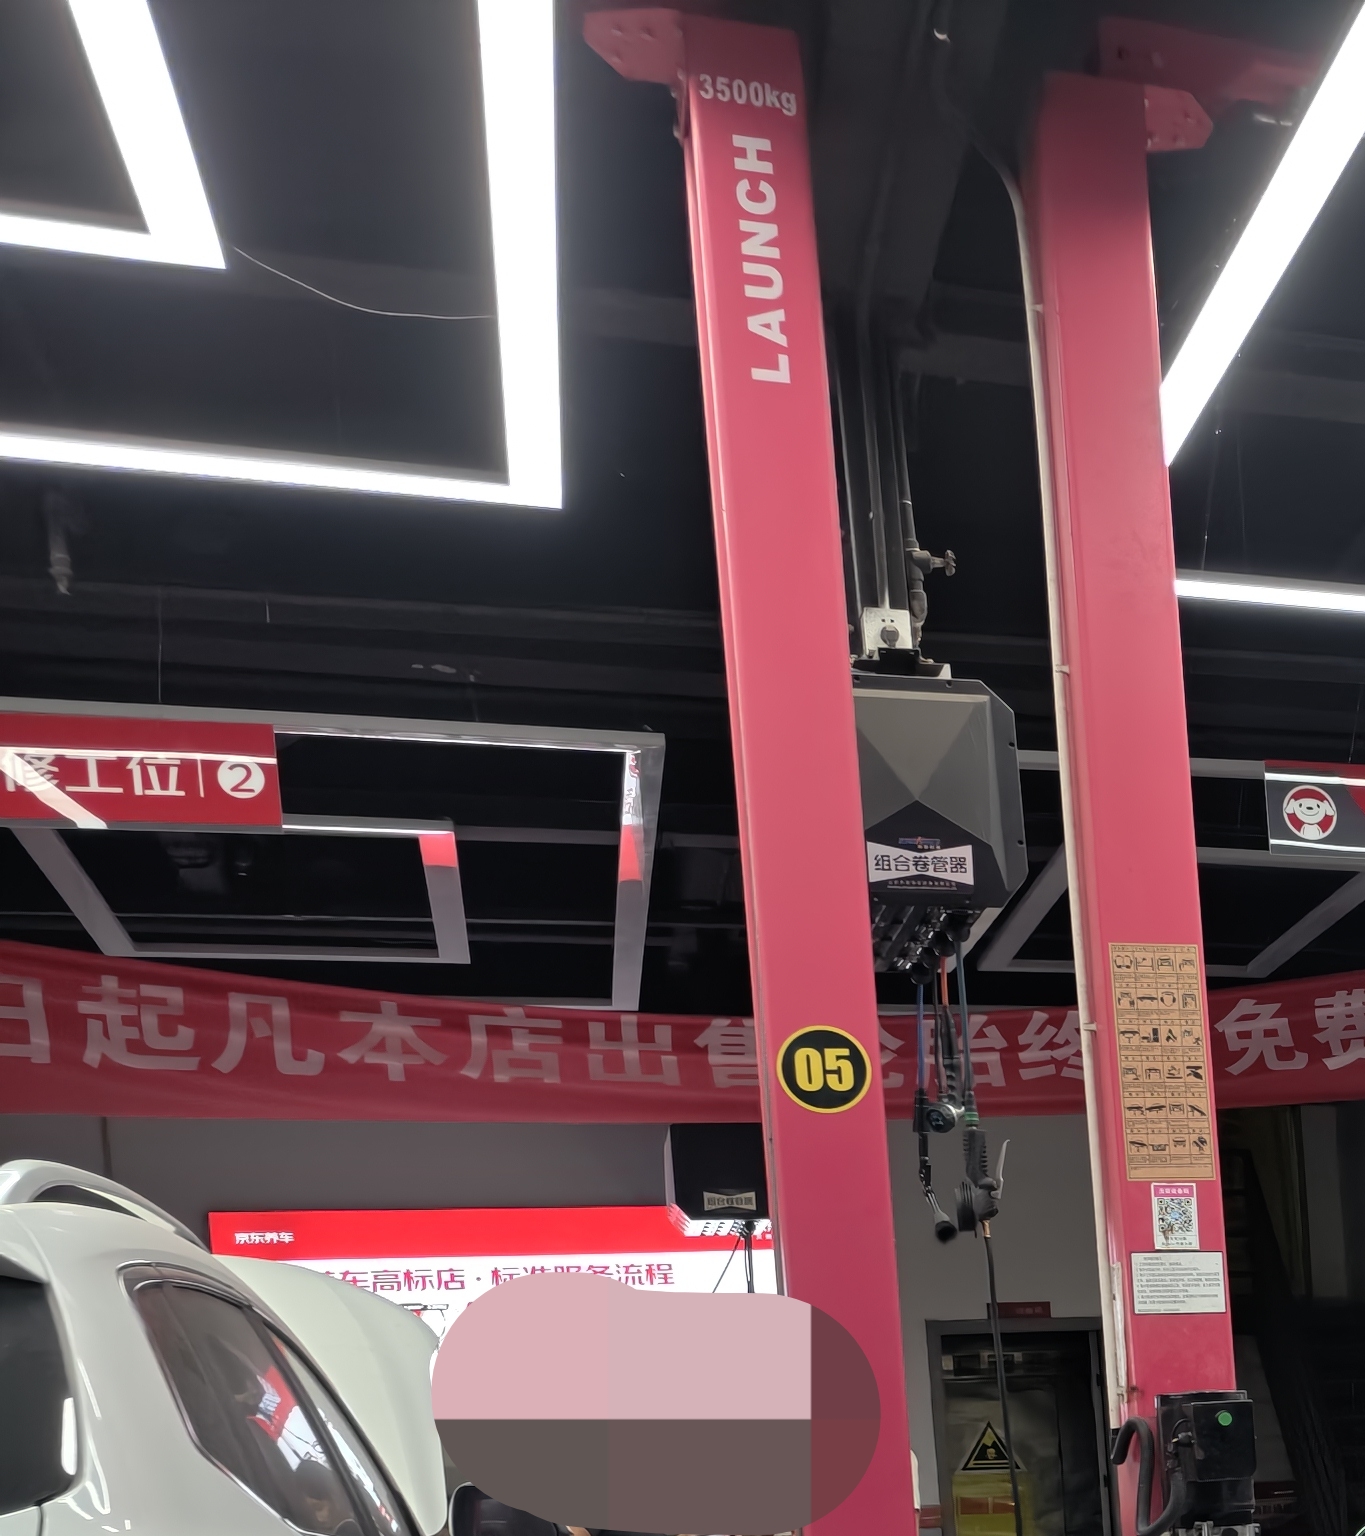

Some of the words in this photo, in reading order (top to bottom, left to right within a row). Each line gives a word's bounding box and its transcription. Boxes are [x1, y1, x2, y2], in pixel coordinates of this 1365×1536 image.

[699, 74, 797, 117] 3500kg
[732, 134, 792, 385] LAUNCH
[874, 854, 967, 874] 组合卷管器
[794, 1047, 855, 1092] 05
[234, 1231, 295, 1245] 京东养车
